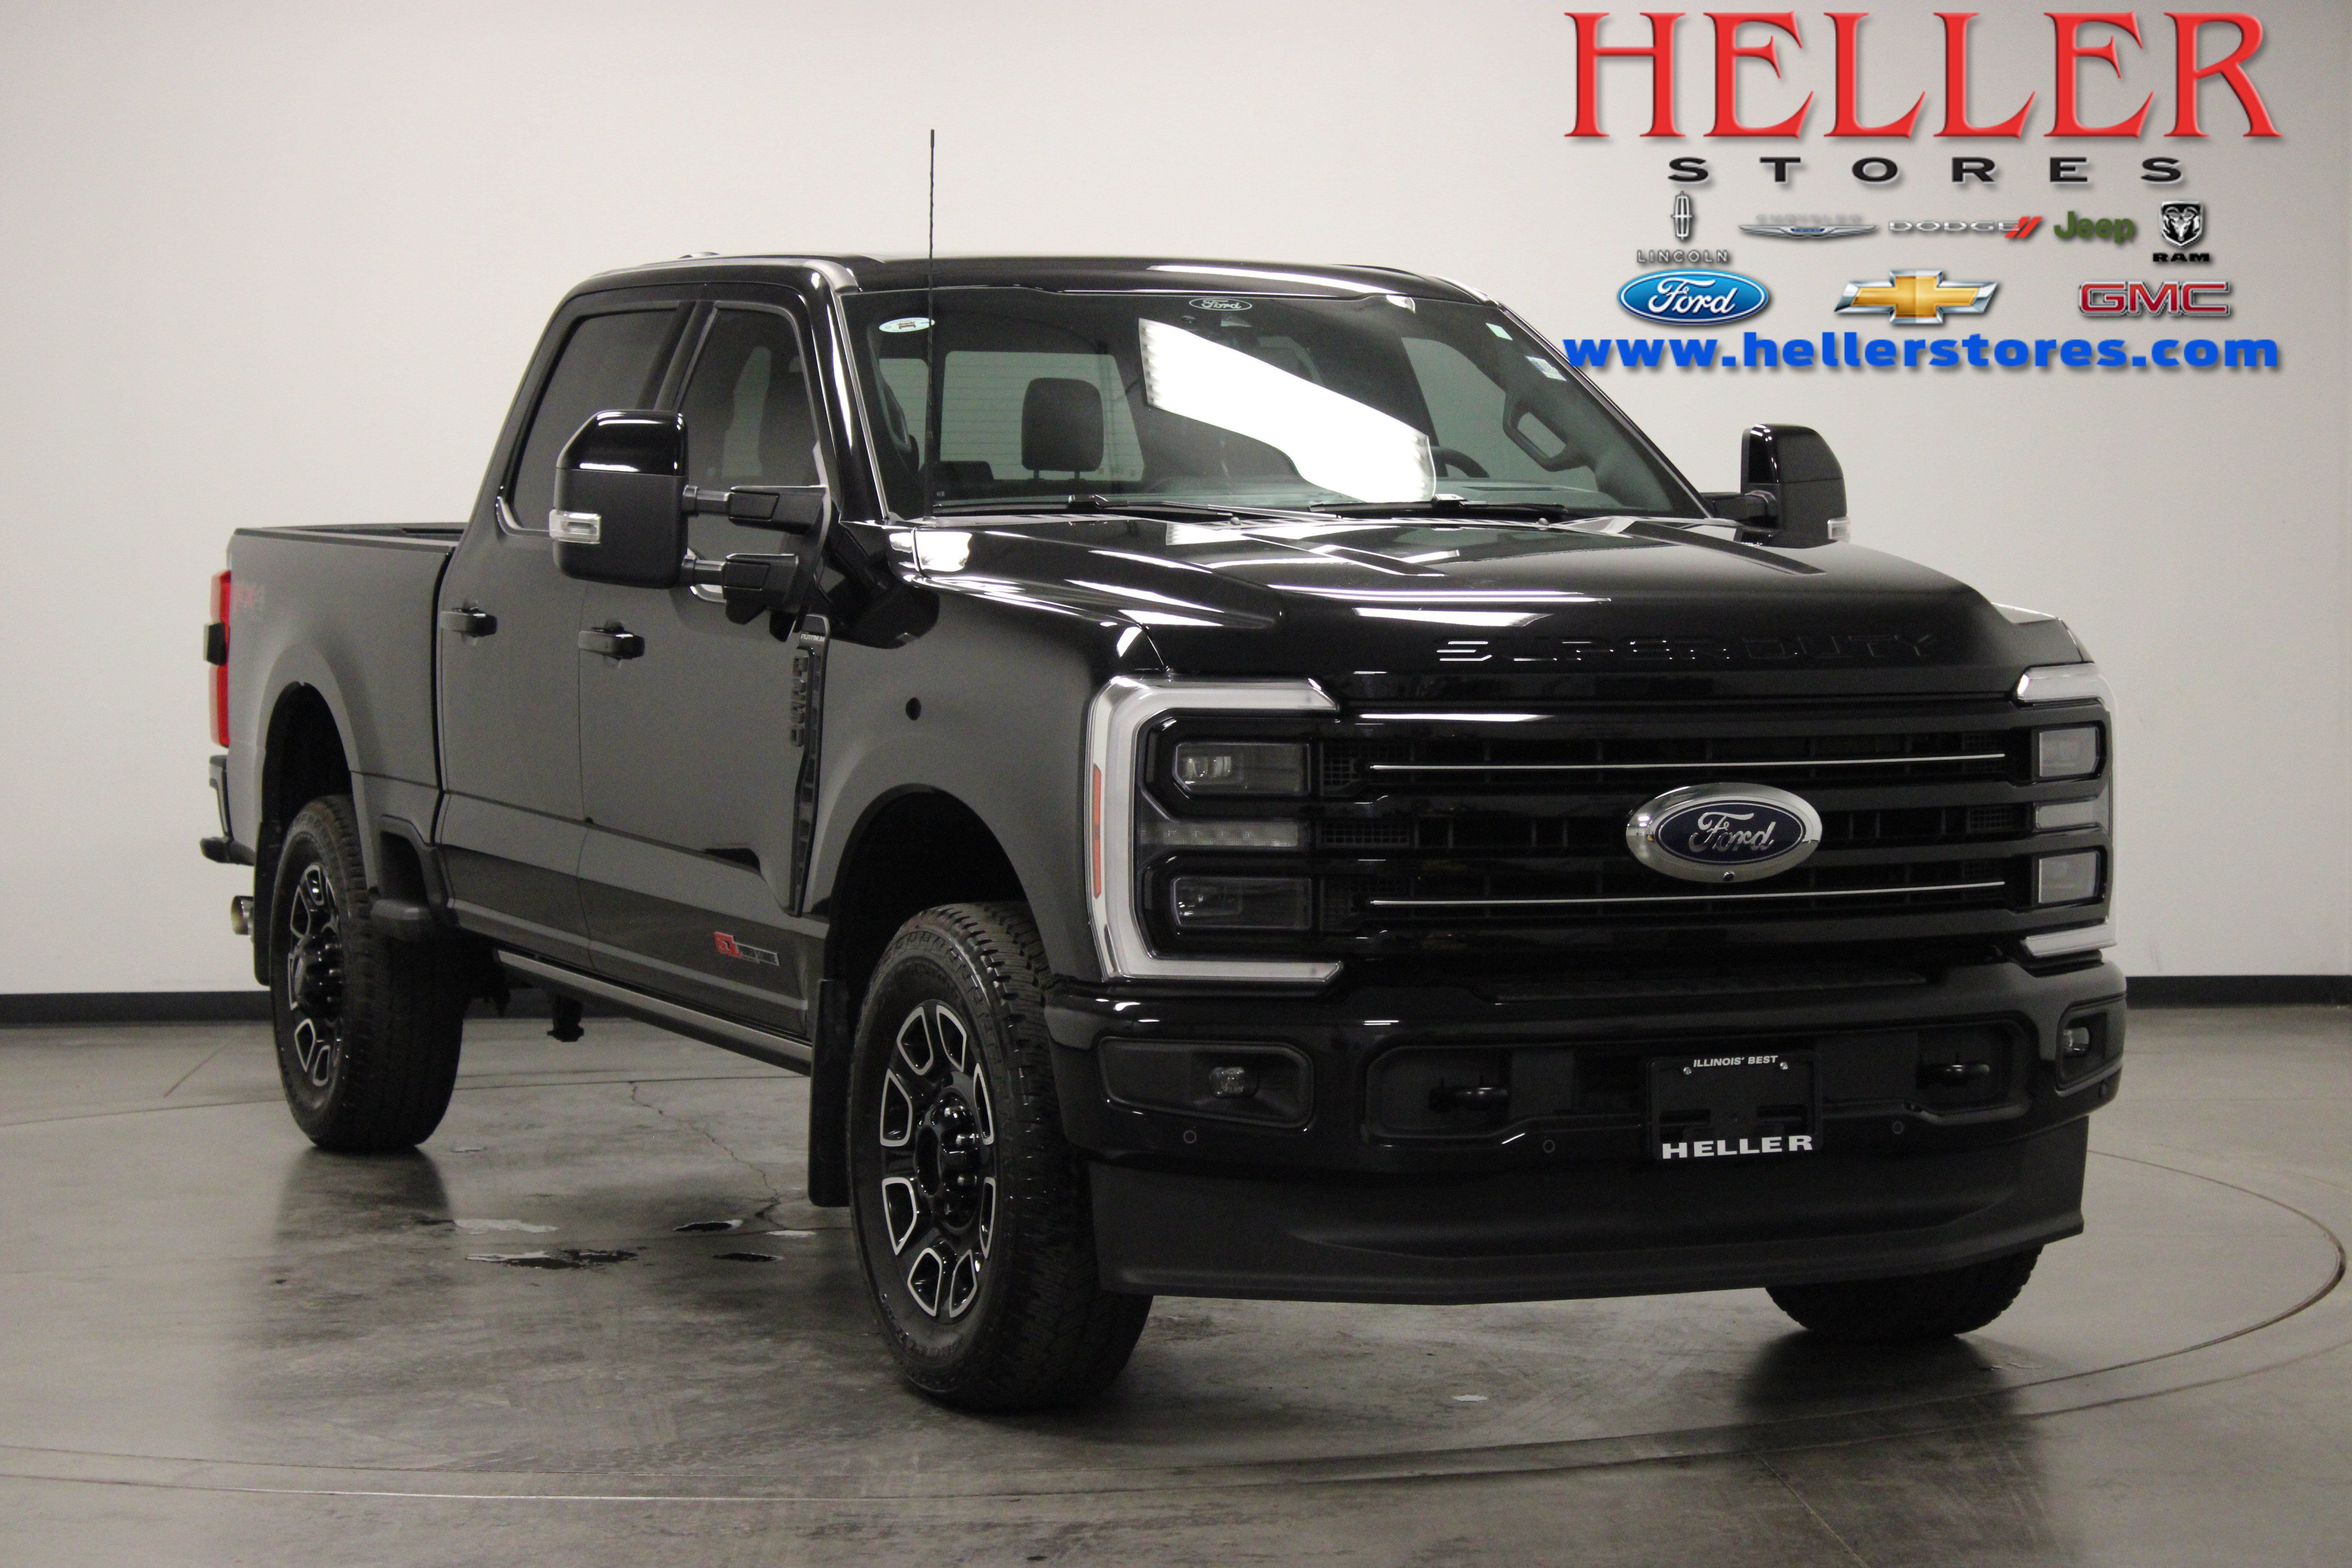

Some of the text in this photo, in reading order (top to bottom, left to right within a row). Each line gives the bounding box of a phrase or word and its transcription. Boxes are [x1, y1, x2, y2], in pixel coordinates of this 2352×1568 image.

[1201, 299, 1242, 309] Ford
[1688, 811, 1777, 853] Ford
[1693, 1055, 1778, 1067] ILLINOIS' BEST
[1662, 1135, 1813, 1159] HELLER
